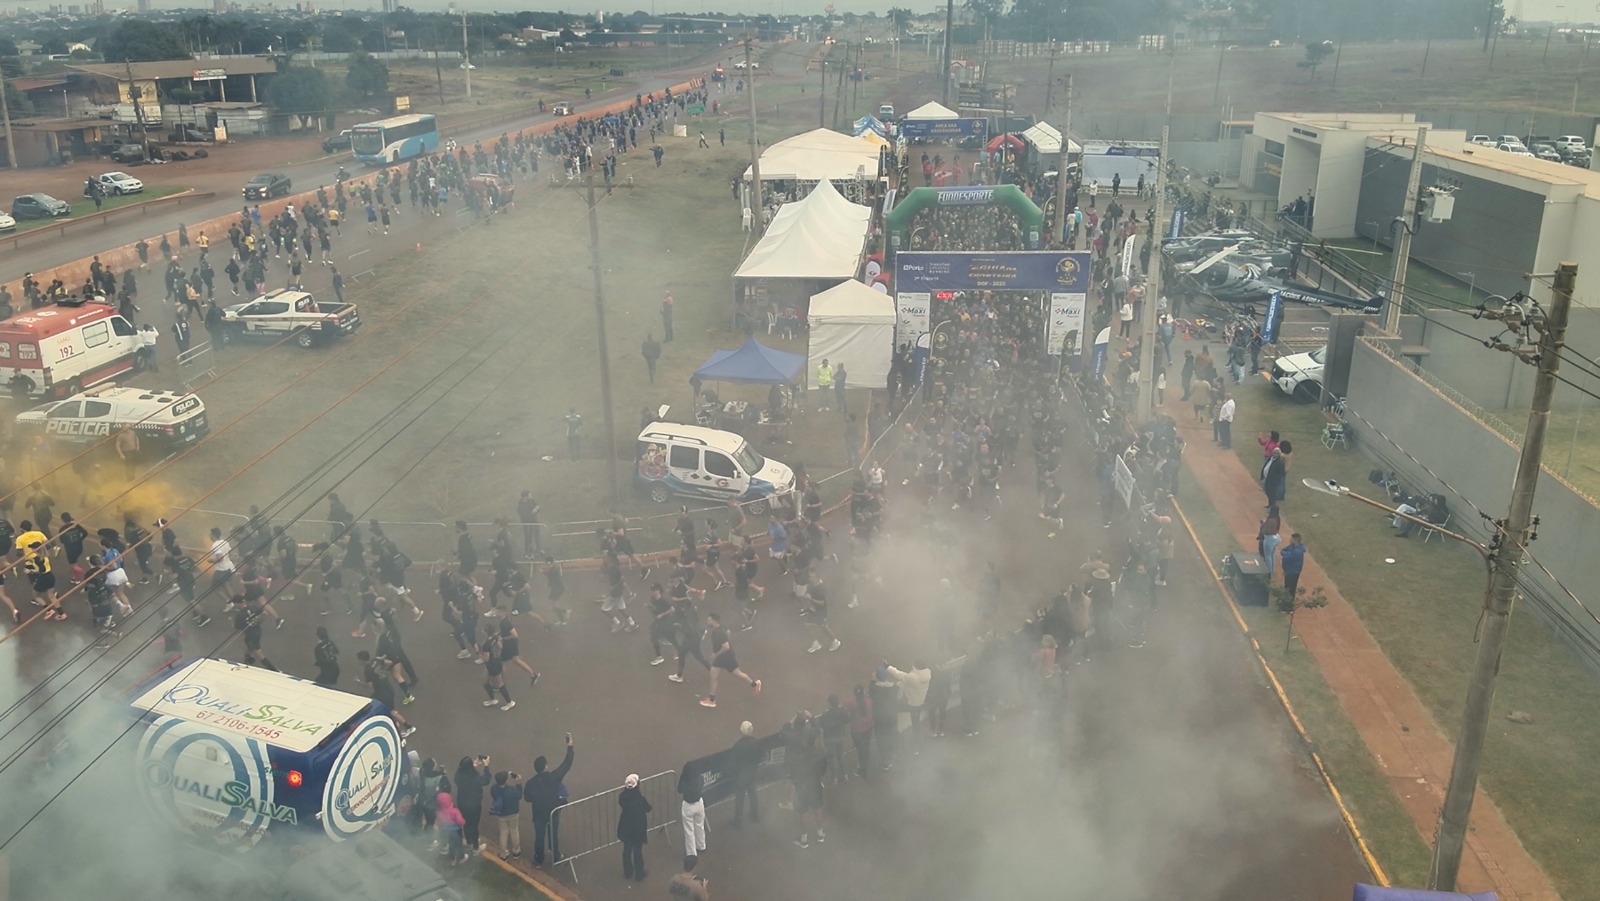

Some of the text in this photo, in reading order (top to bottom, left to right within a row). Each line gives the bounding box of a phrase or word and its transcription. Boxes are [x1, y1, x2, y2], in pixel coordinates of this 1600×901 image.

[938, 190, 994, 203] FUNDESPORTE
[59, 345, 74, 358] 192
[196, 710, 284, 739] 67 2106-1545
